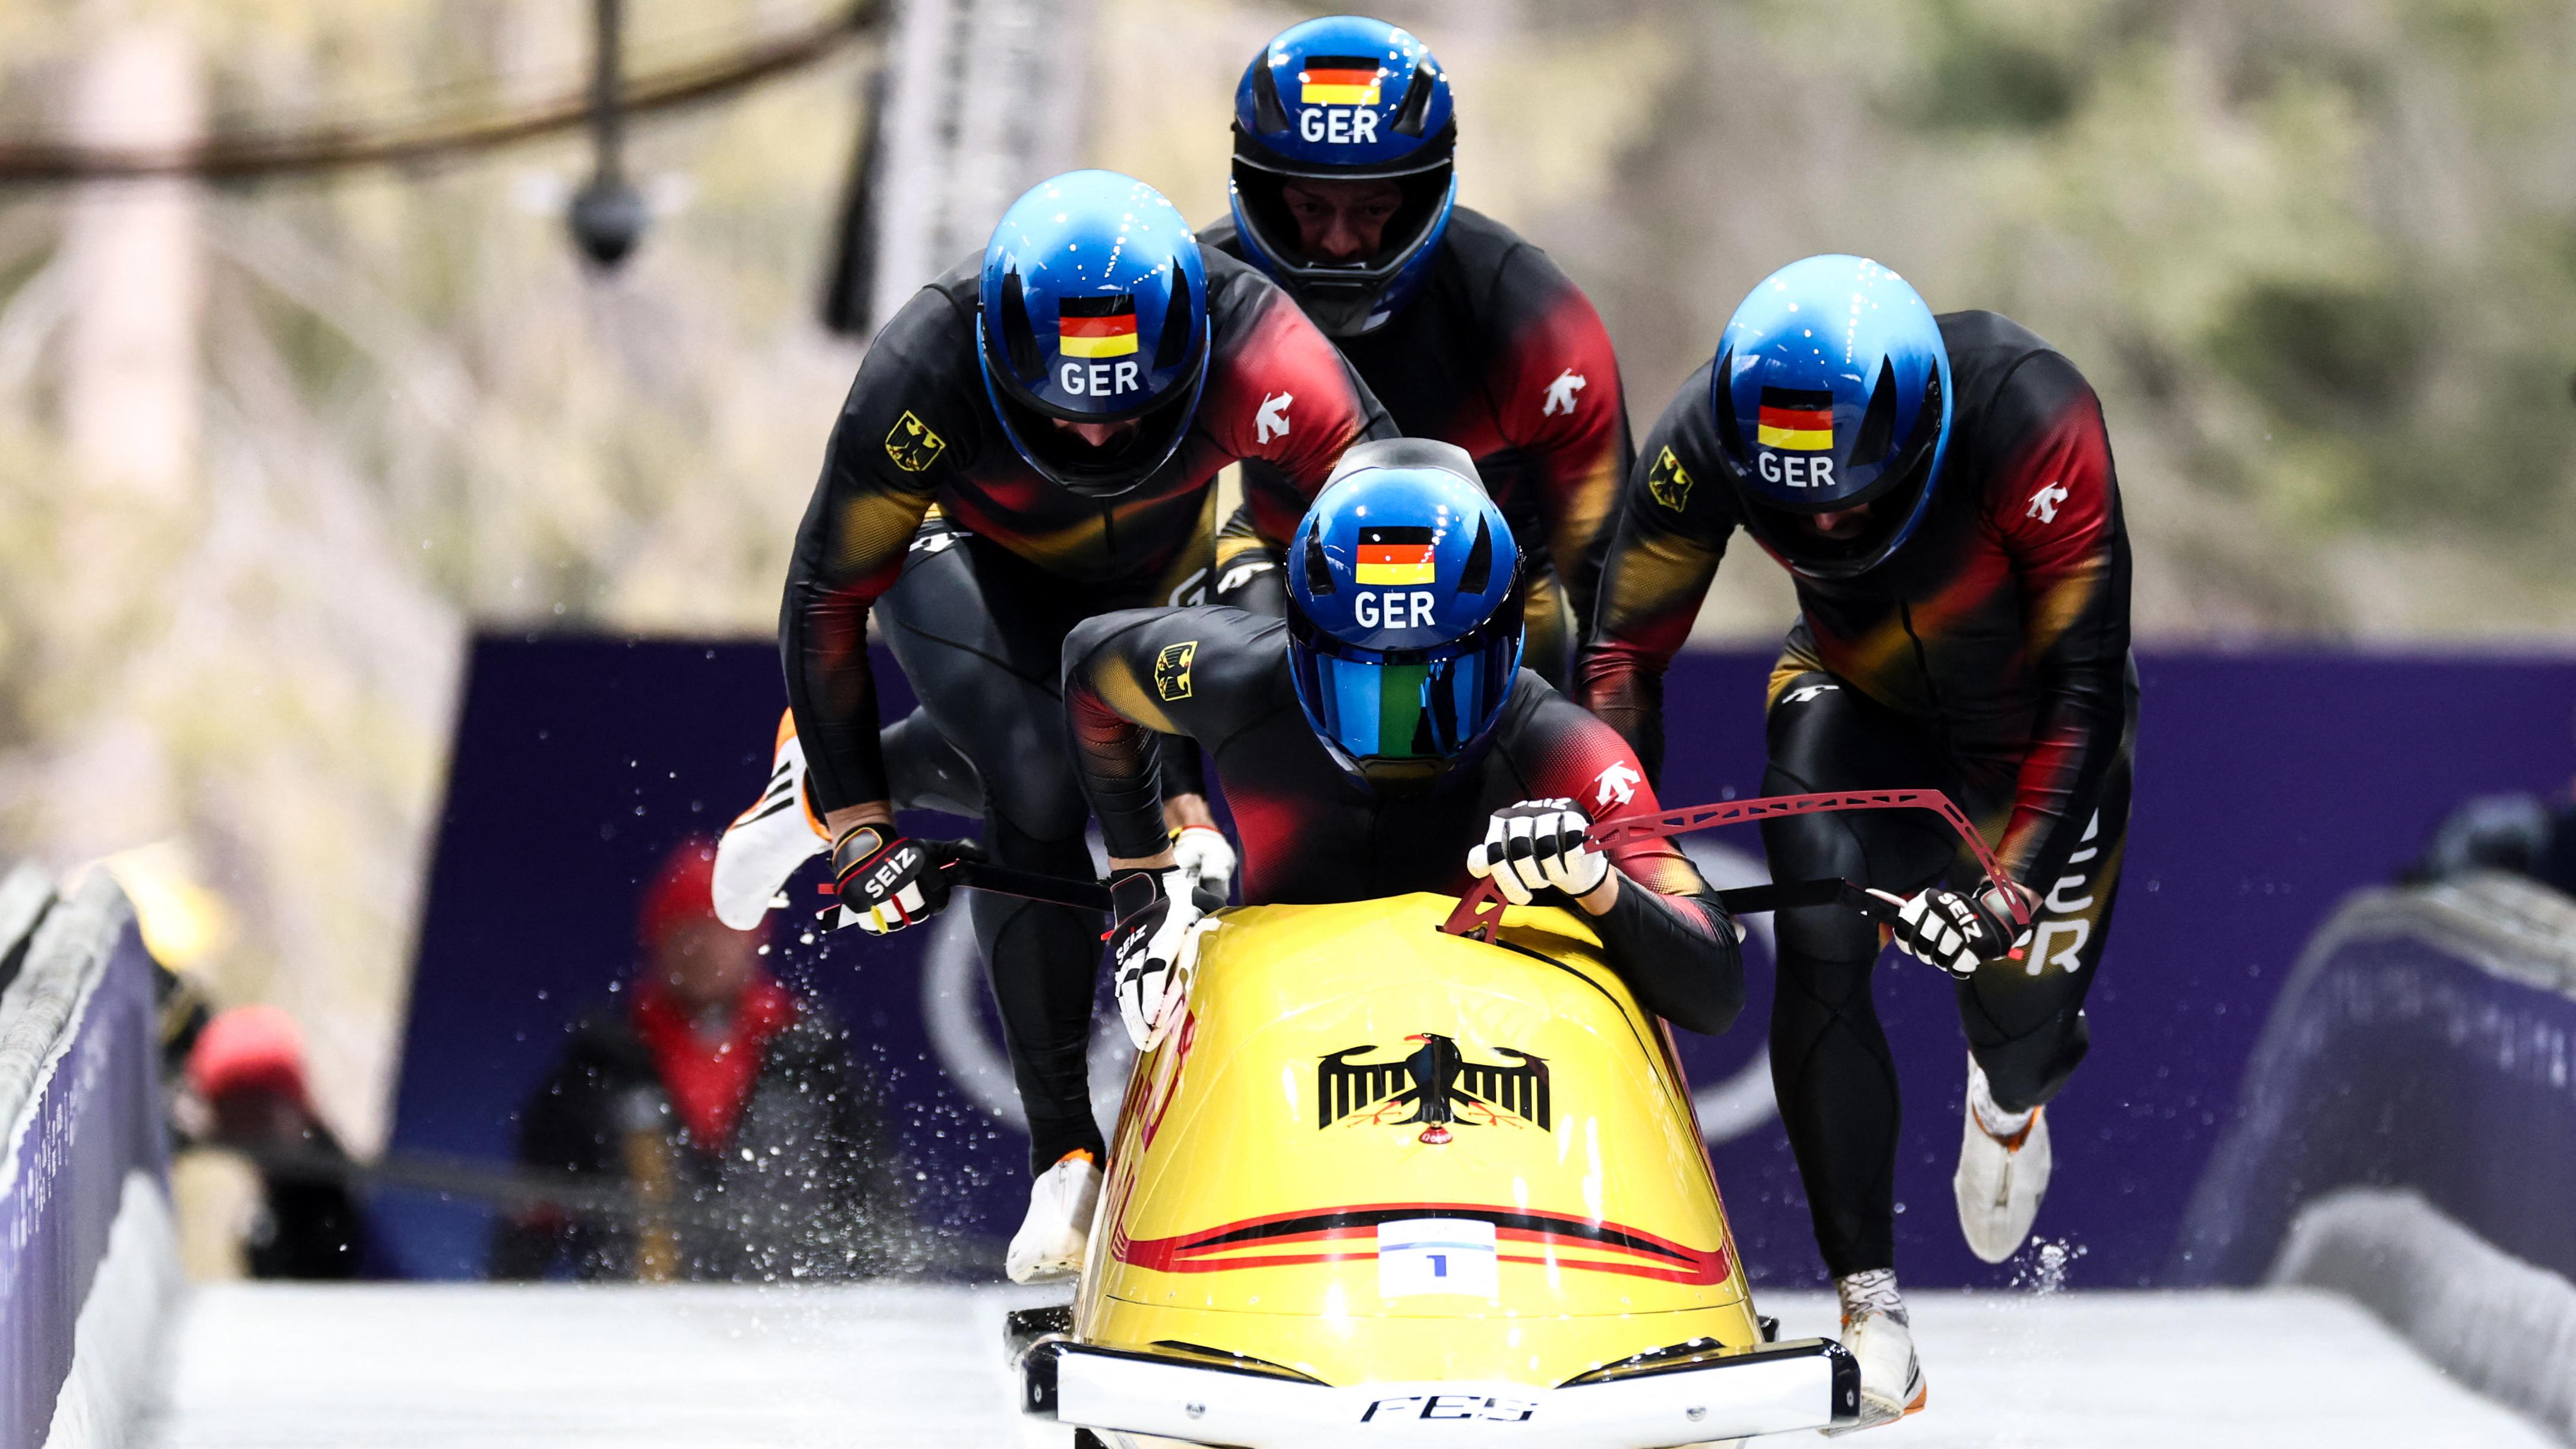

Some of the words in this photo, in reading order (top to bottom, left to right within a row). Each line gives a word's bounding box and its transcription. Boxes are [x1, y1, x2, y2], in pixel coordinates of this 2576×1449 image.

[1300, 108, 1378, 144] GER
[1060, 361, 1139, 396] GER
[1758, 452, 1836, 488] GER
[1355, 591, 1436, 629] GER
[1511, 797, 1572, 810] IZ
[864, 847, 917, 898] SEIZ
[2025, 807, 2098, 976] ER
[1937, 892, 1983, 943] SEIZ
[1116, 924, 1147, 965] SEIZ
[1426, 1255, 1447, 1277] 1
[1360, 1396, 1539, 1423] FES
